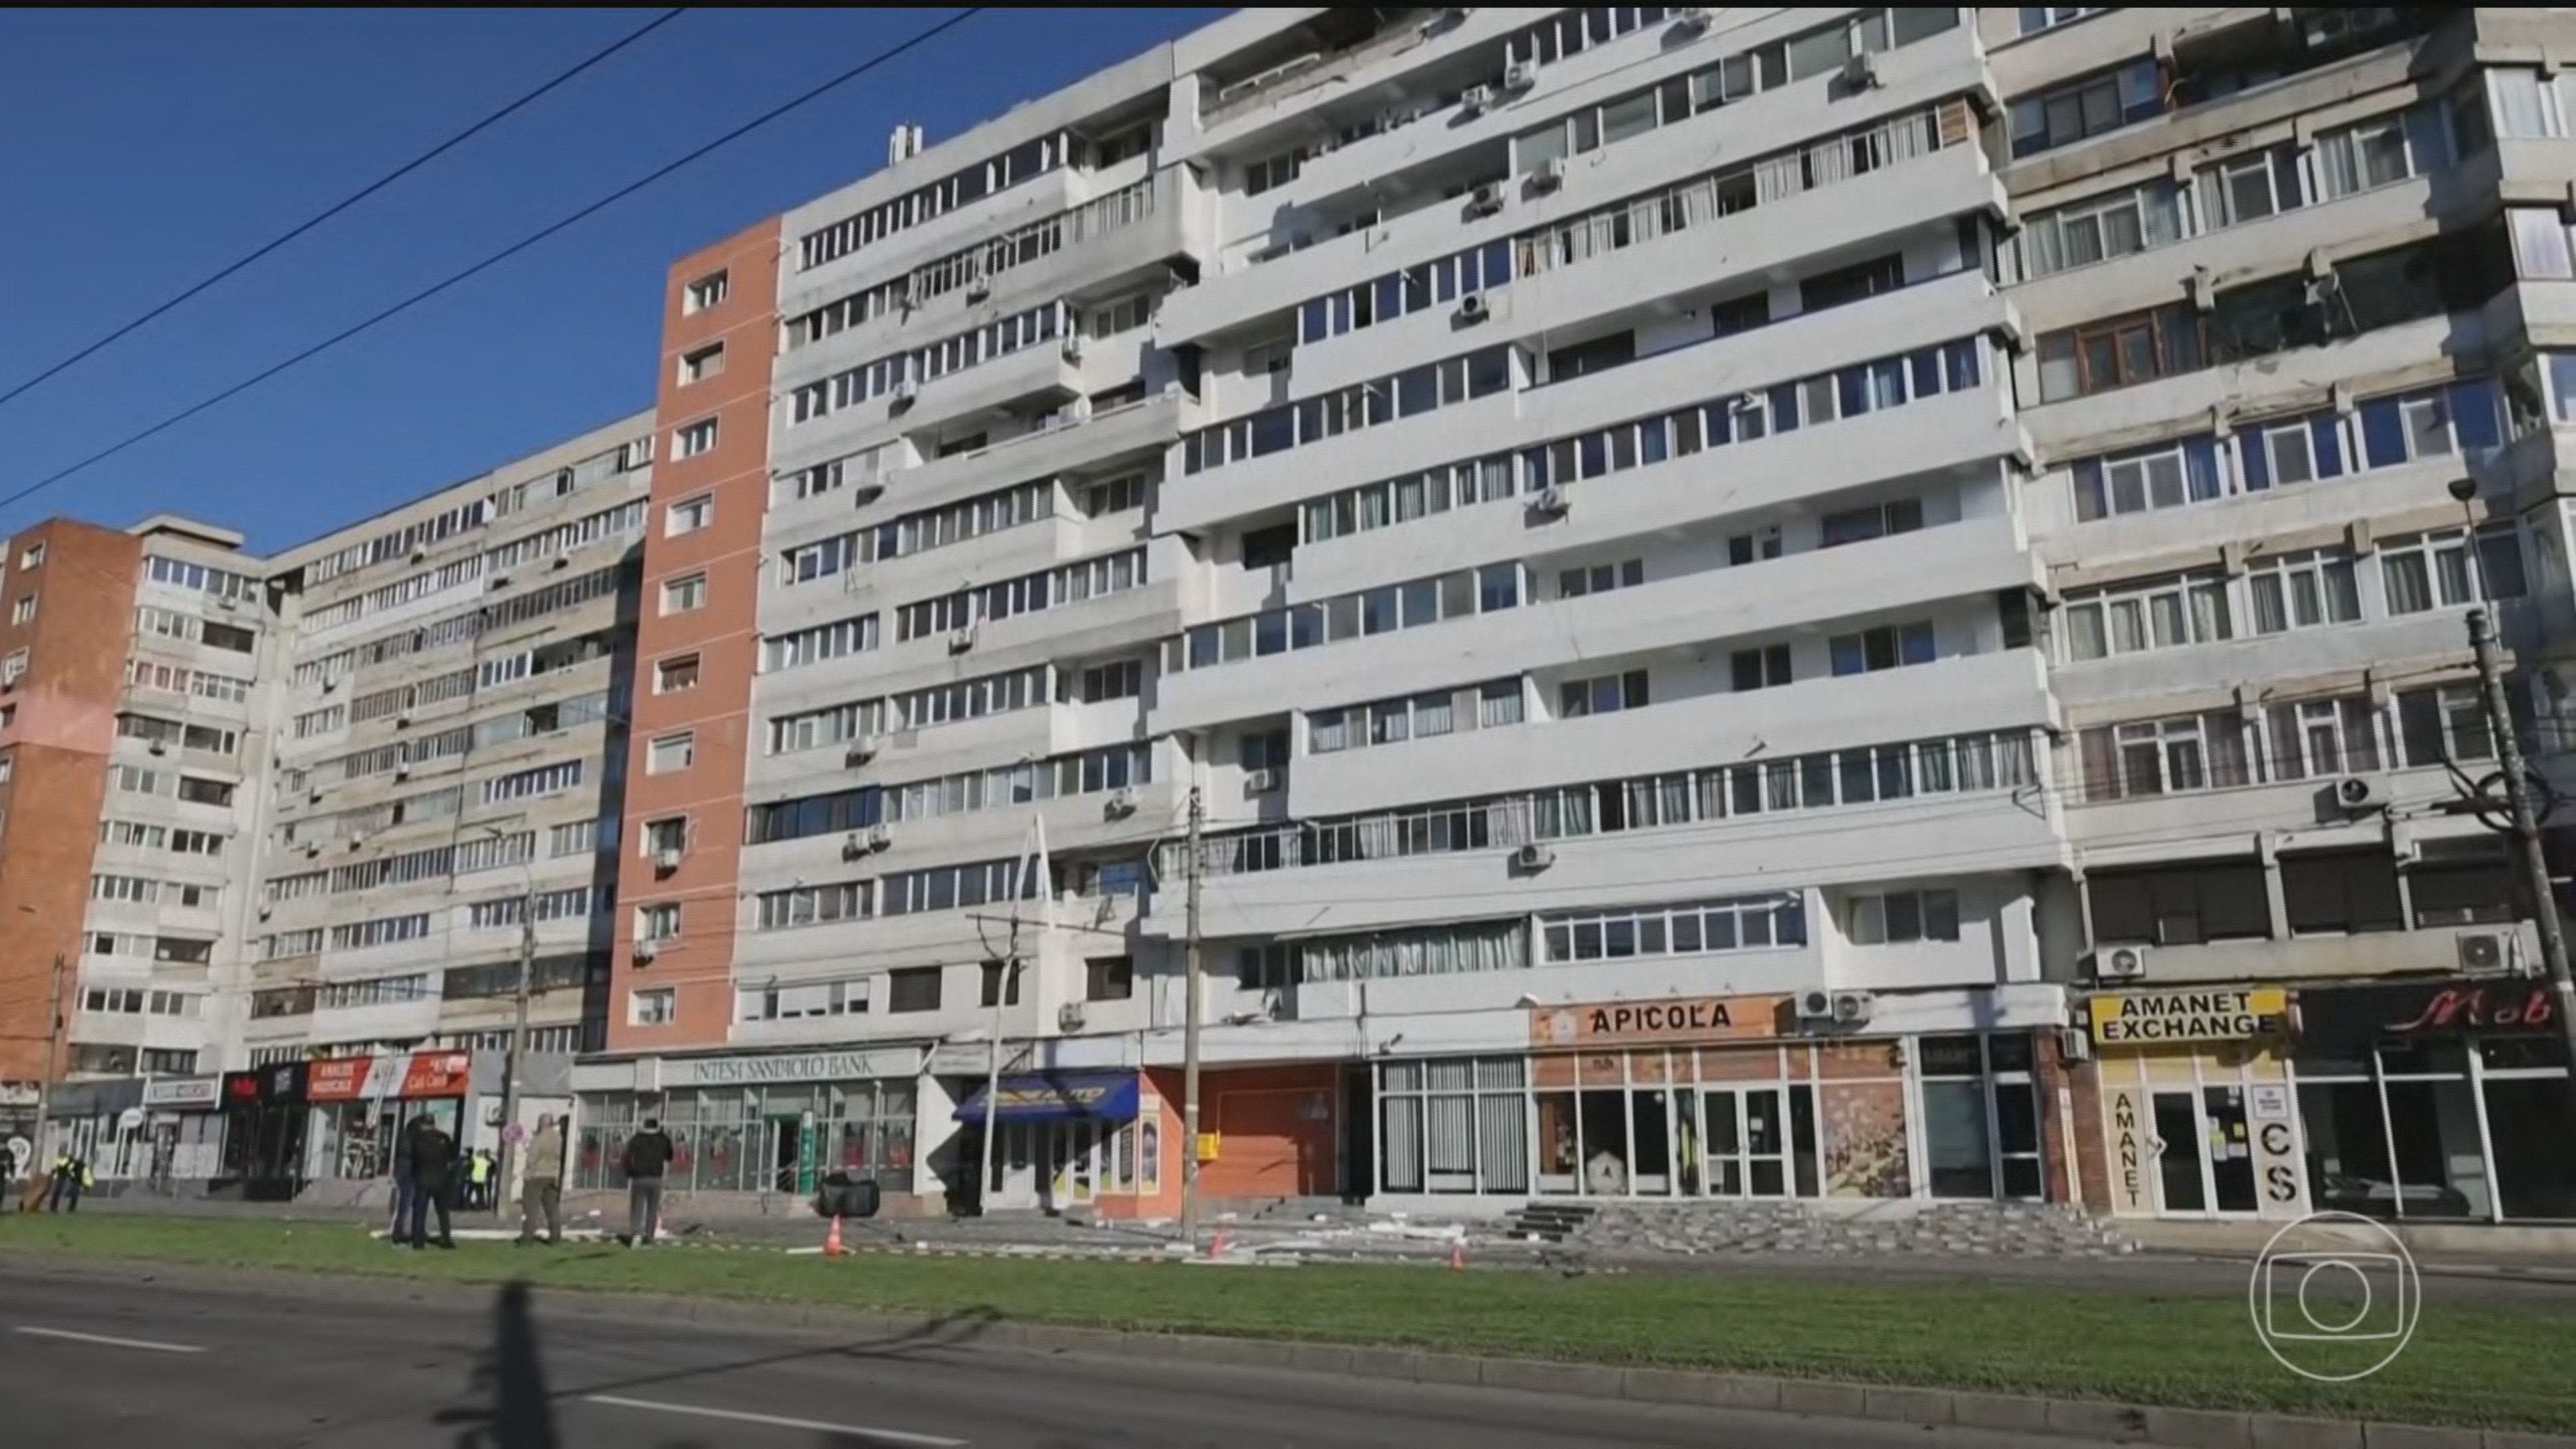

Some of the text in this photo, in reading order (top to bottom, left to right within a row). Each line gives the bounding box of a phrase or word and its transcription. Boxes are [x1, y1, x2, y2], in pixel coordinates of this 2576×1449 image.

[2121, 992, 2250, 1017] AMANET
[1592, 1004, 1731, 1033] APICOLA
[2102, 1014, 2276, 1040] EXCHANGE
[828, 1053, 872, 1075] BANK
[2116, 1092, 2140, 1208] AMANET
